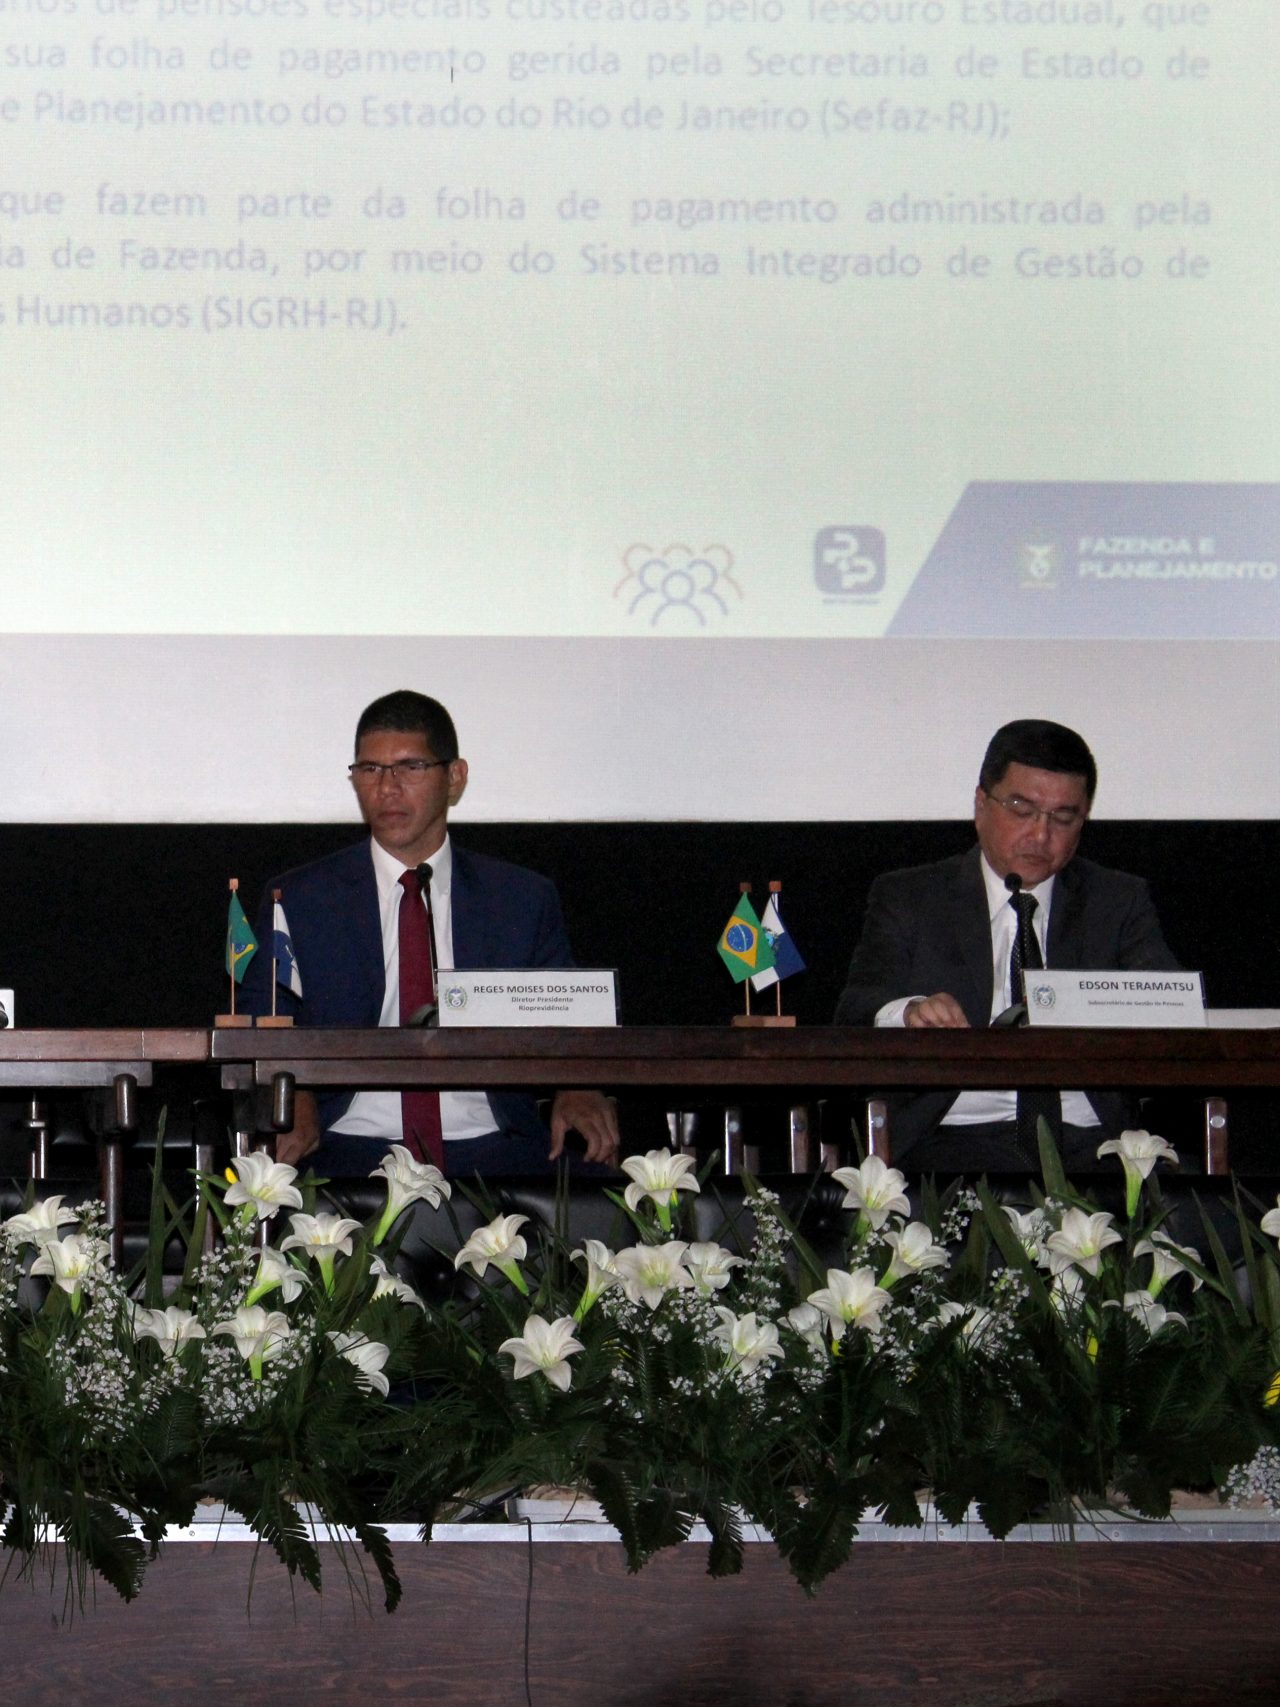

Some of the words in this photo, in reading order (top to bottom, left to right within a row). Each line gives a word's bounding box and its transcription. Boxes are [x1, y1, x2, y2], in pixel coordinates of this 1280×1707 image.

[324, 0, 491, 25] especiais
[506, 0, 691, 21] custeadas
[705, 0, 784, 28] pelo
[960, 0, 1126, 29] Estadual,
[1142, 0, 1210, 31] que
[5, 43, 67, 68] sua
[91, 36, 185, 70] folha
[209, 38, 253, 71] de
[279, 47, 486, 79] pagamento
[508, 42, 620, 82] gerida
[646, 44, 724, 80] pela
[745, 45, 929, 77] Secretaria
[954, 46, 999, 78] de
[1021, 47, 1144, 79] Estado
[1165, 47, 1211, 79] de
[0, 101, 20, 122] e
[33, 90, 291, 131] Planejamento
[300, 95, 347, 127] do
[362, 96, 487, 128] Estado
[496, 97, 542, 129] do
[552, 98, 611, 129] Rio
[621, 98, 664, 129] de
[675, 99, 809, 131] Janeiro
[819, 98, 1011, 139] (Sefaz-RJ);
[96, 182, 206, 215] fazem
[238, 190, 332, 222] parte
[362, 188, 406, 219] da
[435, 187, 526, 220] folha
[557, 190, 600, 221] de
[632, 196, 837, 229] pagamento
[865, 191, 1105, 224] administrada
[1135, 194, 1211, 231] pela
[51, 237, 95, 269] de
[119, 238, 280, 277] Fazenda,
[304, 248, 365, 278] por
[391, 241, 483, 273] meio
[508, 243, 555, 274] do
[580, 243, 720, 275] Sistema
[746, 245, 921, 285] Integrado
[946, 245, 991, 278] de
[1015, 245, 1144, 279] Gestão
[1165, 247, 1210, 279] de
[17, 294, 191, 328] Humanos
[201, 295, 408, 337] (SIGRH-RJ).
[1077, 536, 1191, 555] FAZENDA
[1199, 536, 1215, 555] E
[1077, 560, 1279, 580] PLANEJAMENTO
[473, 985, 504, 994] REGES
[506, 985, 544, 994] MOISES
[547, 985, 568, 994] DOS
[570, 985, 609, 994] SANTOS
[1079, 981, 1119, 990] EDSON
[1122, 981, 1194, 991] TERAMATSU
